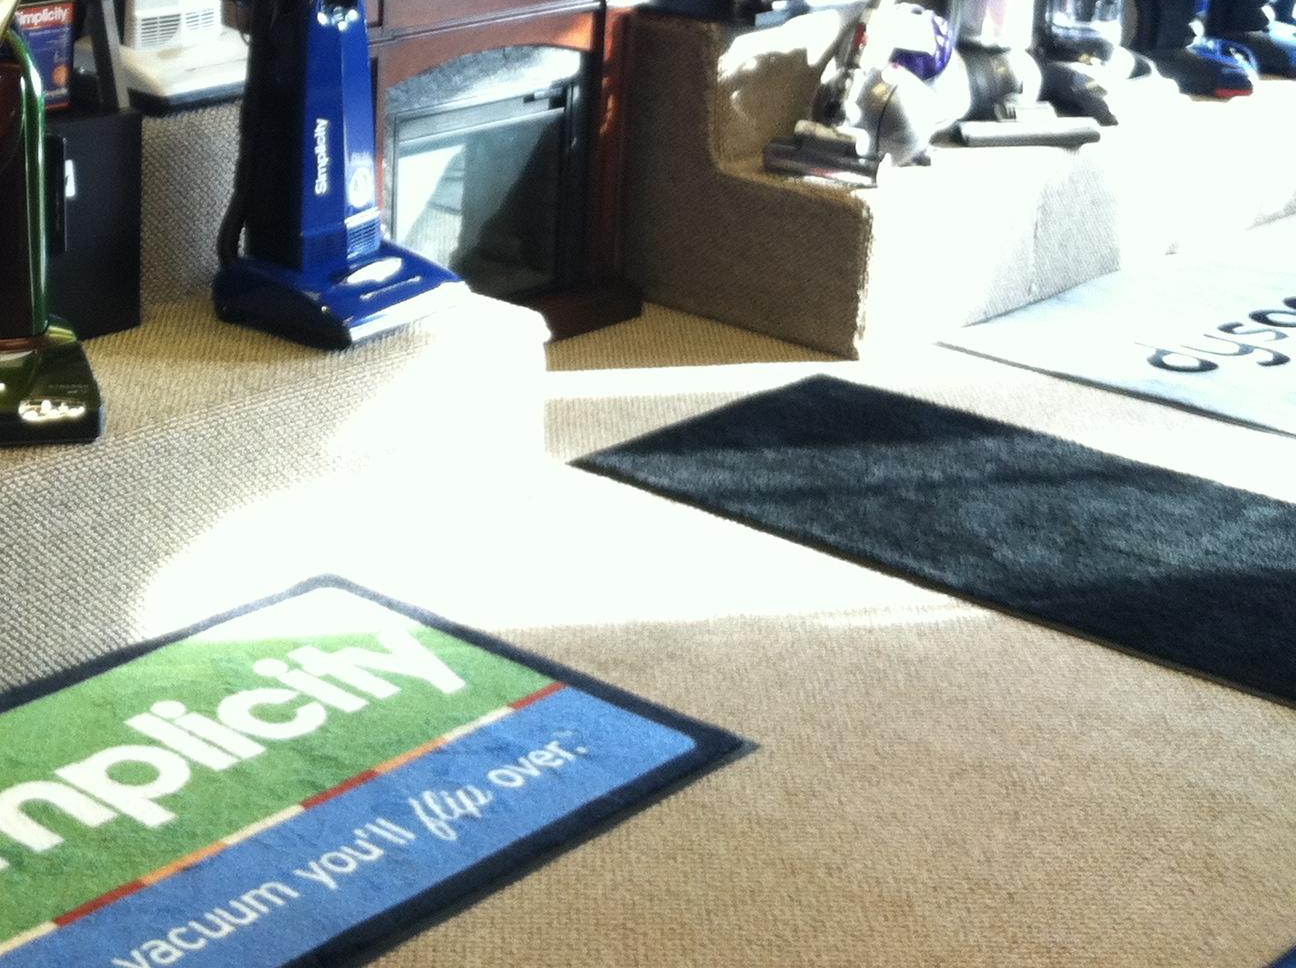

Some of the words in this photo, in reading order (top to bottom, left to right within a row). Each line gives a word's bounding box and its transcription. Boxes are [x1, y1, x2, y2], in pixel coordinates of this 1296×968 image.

[313, 118, 330, 195] Simplicity
[1135, 296, 1296, 374] dyso
[112, 880, 301, 968] vacuum
[295, 817, 417, 890] you'll
[408, 785, 493, 841] flip
